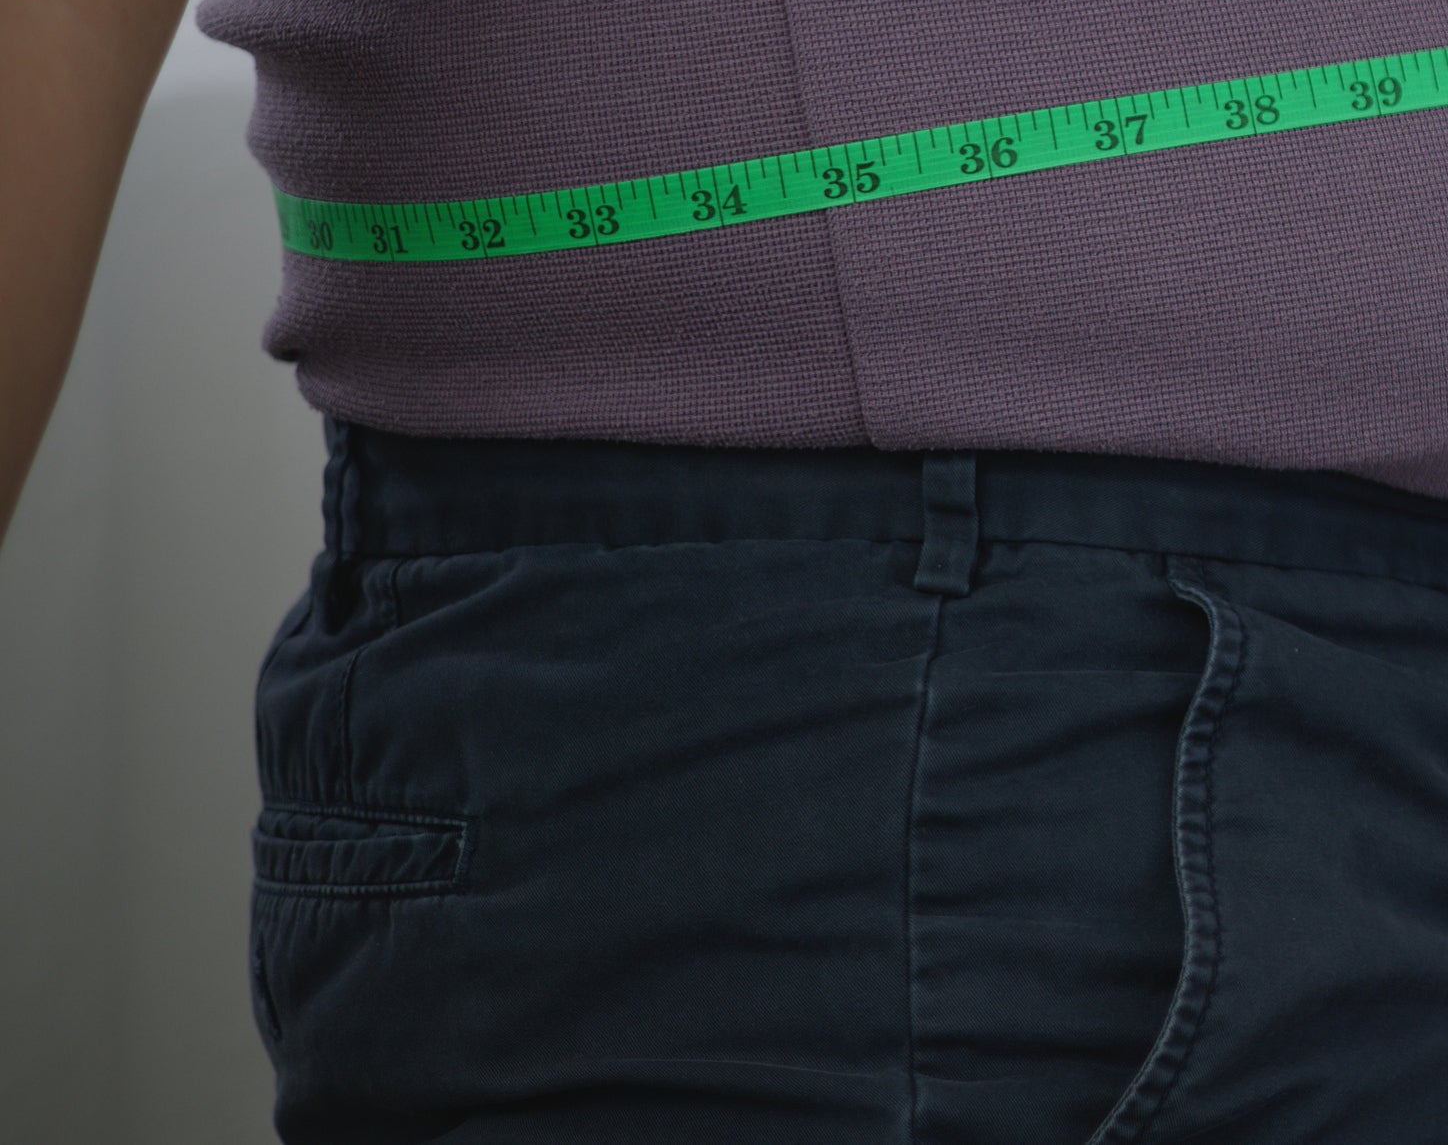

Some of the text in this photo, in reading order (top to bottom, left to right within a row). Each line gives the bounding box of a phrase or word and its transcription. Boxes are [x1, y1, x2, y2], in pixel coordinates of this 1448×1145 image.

[308, 220, 334, 251] 30
[371, 224, 409, 254] 31
[459, 218, 506, 251] 32
[567, 204, 621, 239] 33
[691, 184, 748, 222] 34
[822, 161, 881, 200] 35
[959, 137, 1019, 175] 36
[1094, 112, 1149, 152] 37
[1223, 94, 1281, 130] 38
[1349, 76, 1404, 111] 39
